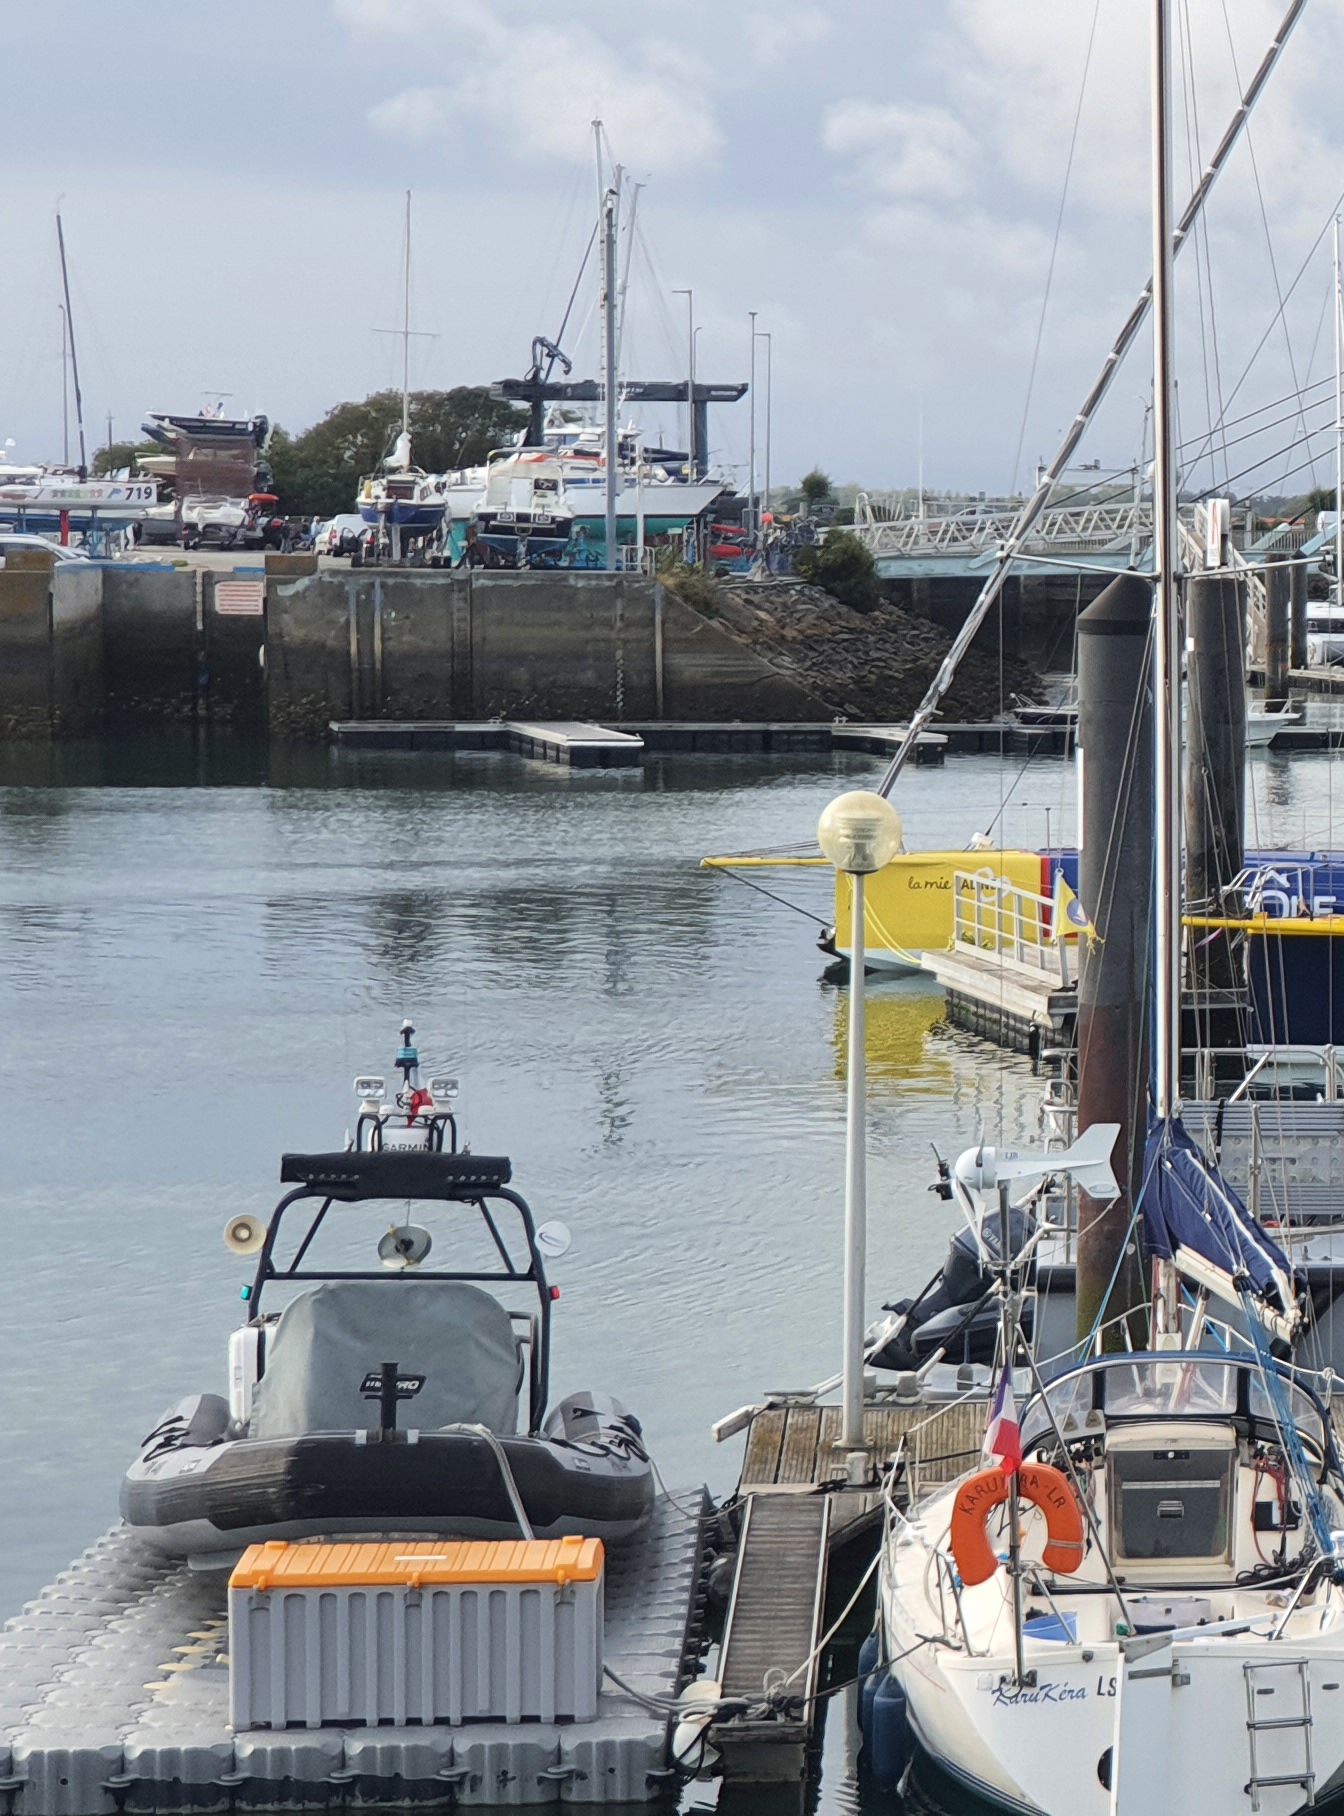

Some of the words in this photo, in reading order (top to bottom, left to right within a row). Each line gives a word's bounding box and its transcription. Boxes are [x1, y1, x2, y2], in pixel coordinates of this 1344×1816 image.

[125, 487, 153, 500] 719
[923, 876, 951, 890] mie
[1097, 1675, 1117, 1697] LS
